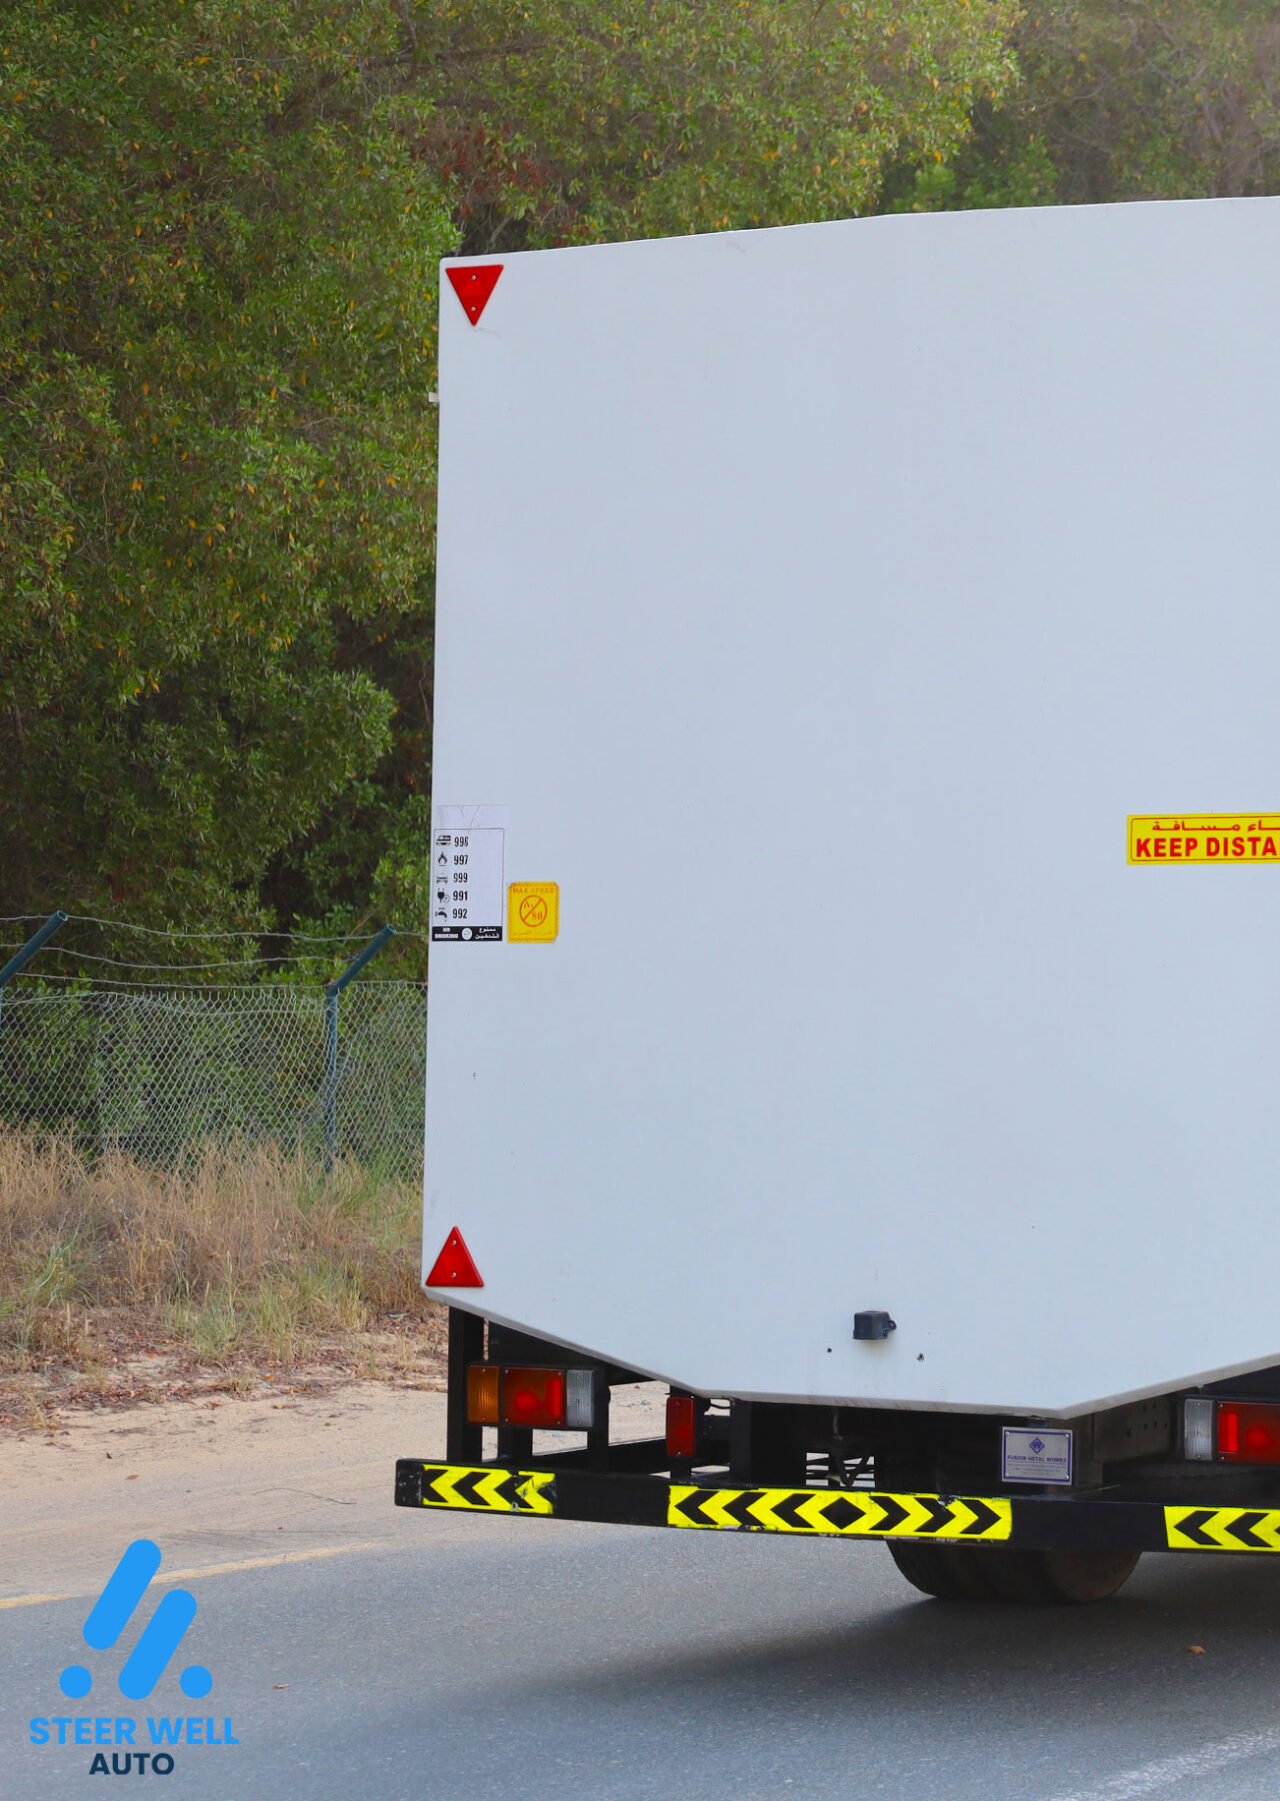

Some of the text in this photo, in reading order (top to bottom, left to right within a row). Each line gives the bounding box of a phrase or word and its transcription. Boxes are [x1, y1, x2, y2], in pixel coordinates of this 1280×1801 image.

[1136, 837, 1198, 858] KEEP
[453, 854, 469, 865] 997
[453, 872, 468, 883] 999
[452, 890, 468, 901] 991
[452, 908, 468, 919] 992
